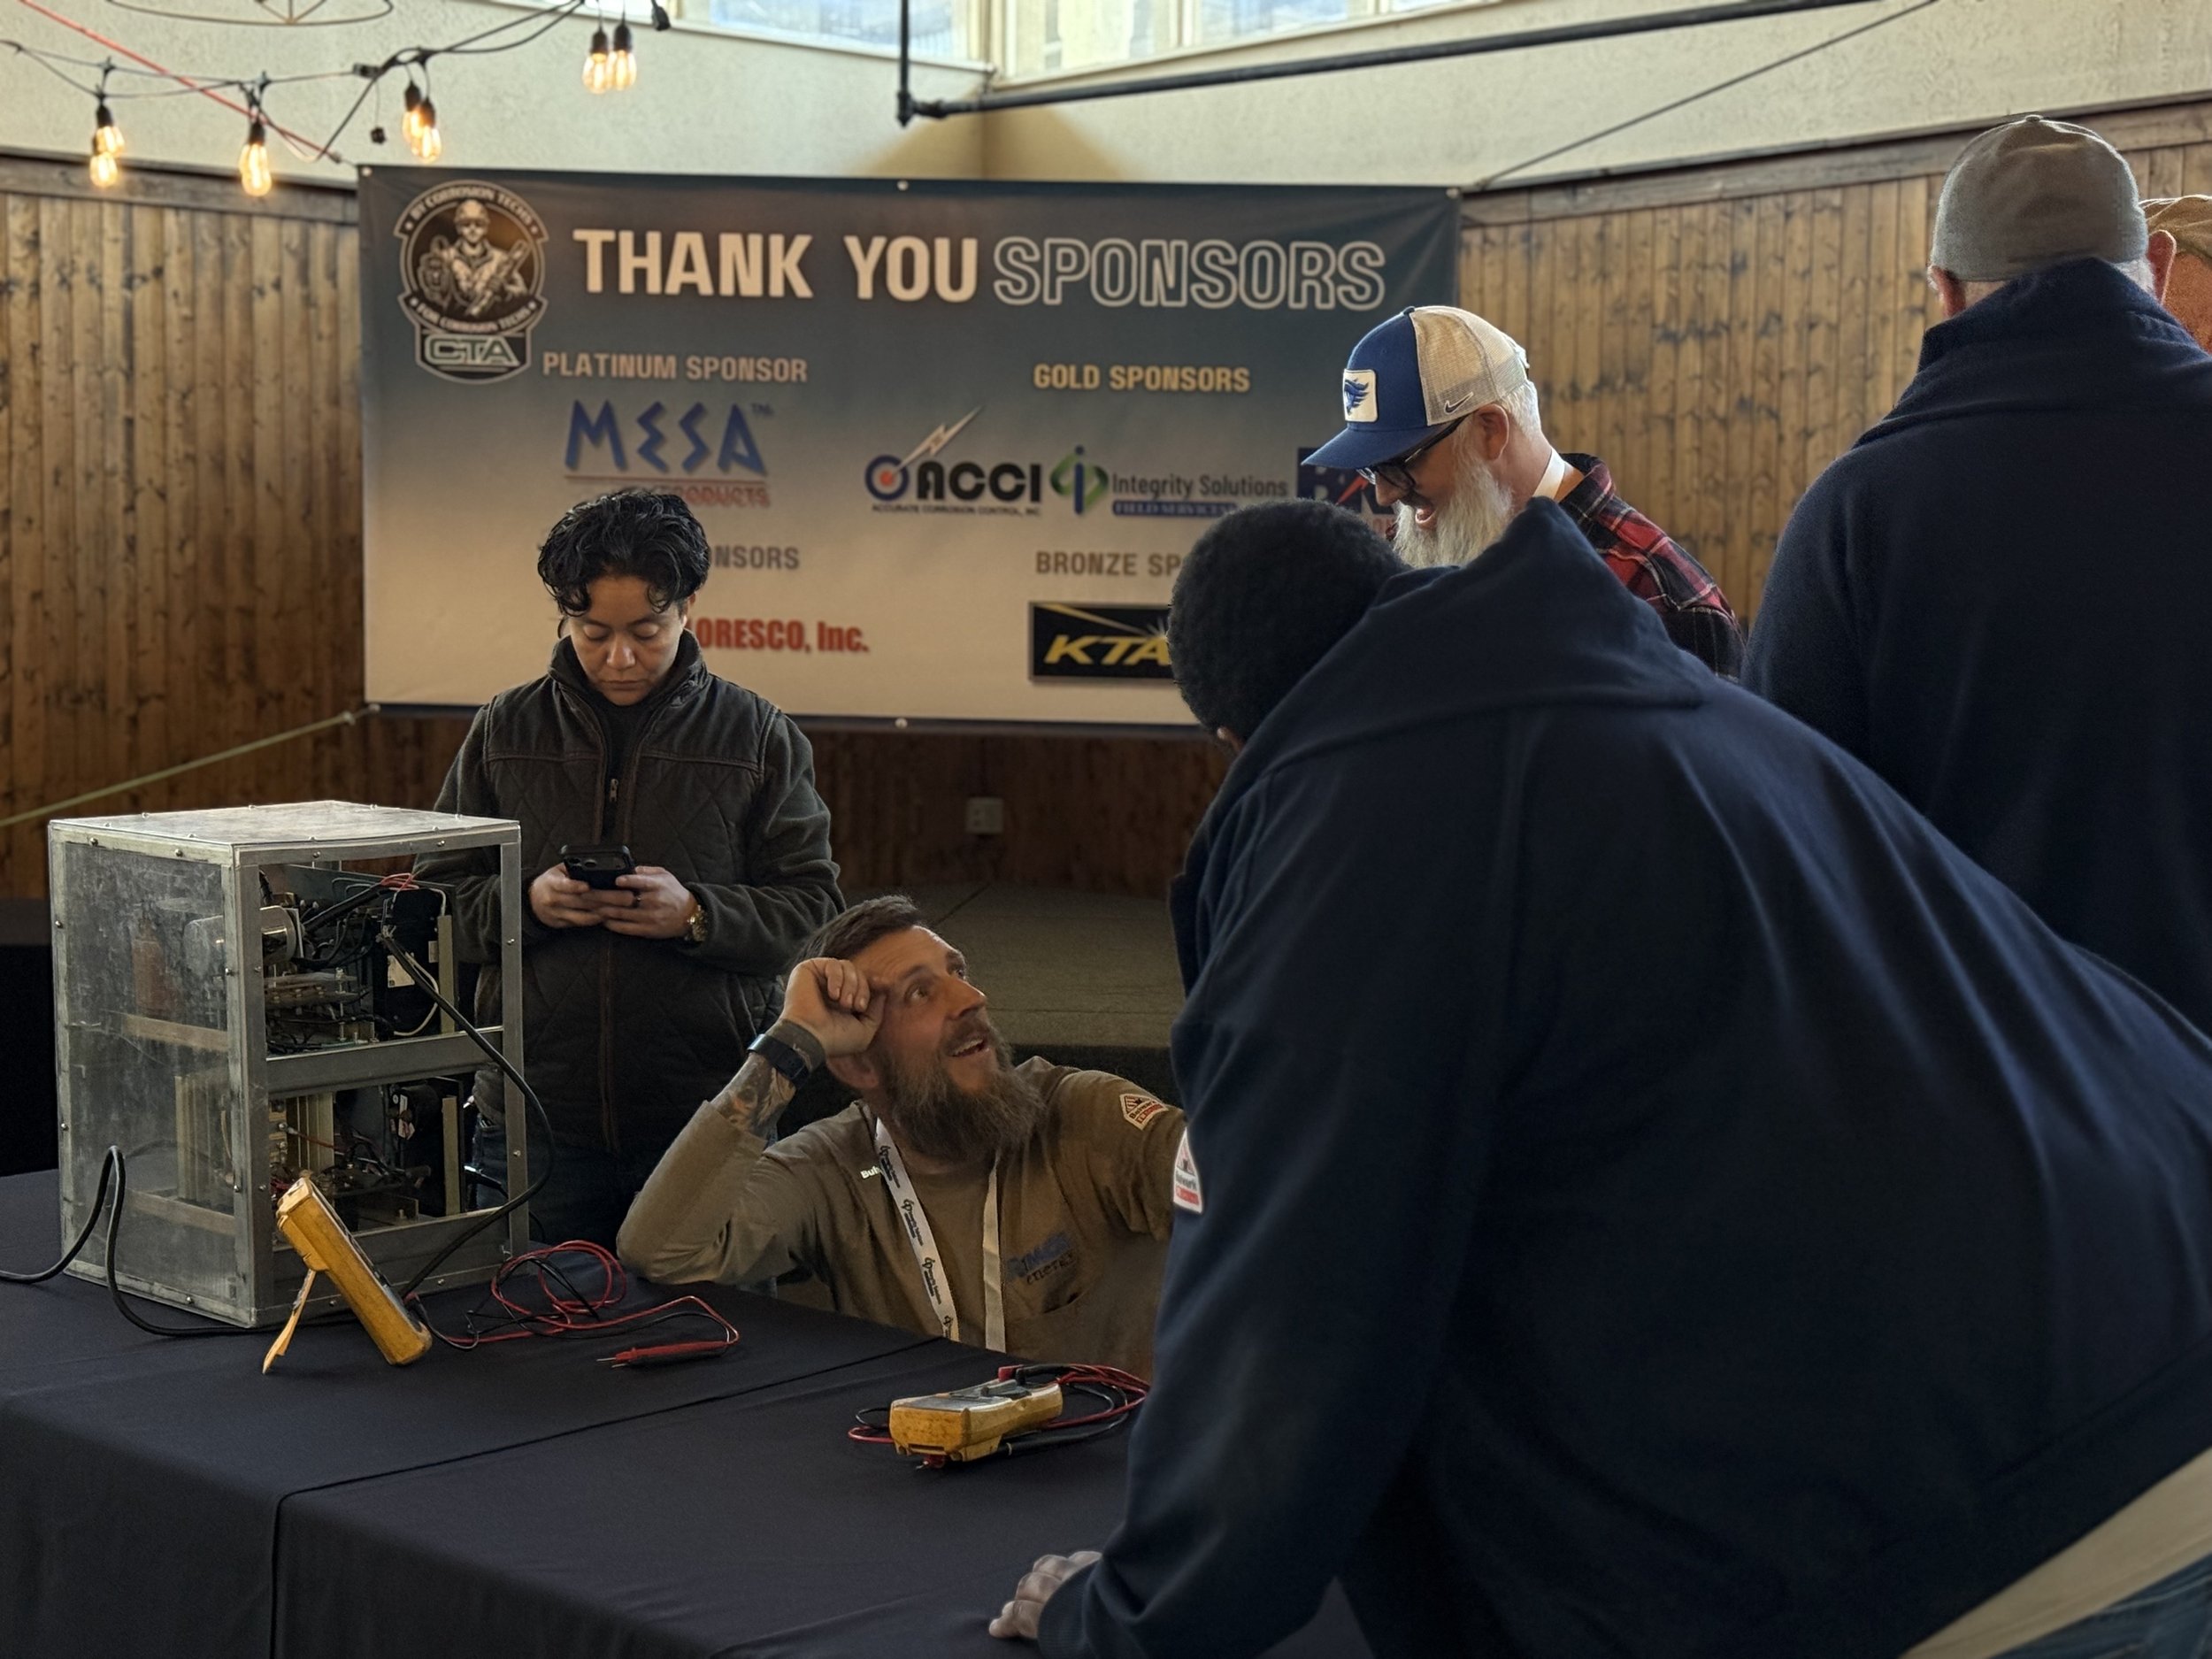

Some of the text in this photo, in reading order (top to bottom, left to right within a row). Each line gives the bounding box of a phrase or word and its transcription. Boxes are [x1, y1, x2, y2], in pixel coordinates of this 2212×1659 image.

[572, 229, 1386, 311] THANK YOU SPONSORS
[425, 334, 519, 366] CTA
[542, 351, 808, 383] PLATINUM SPONSOR
[1033, 364, 1250, 392] GOLD SPONSORS
[565, 399, 768, 476] MESA
[918, 460, 1041, 503] ACCI
[1112, 473, 1288, 498] Integrity Solutions
[1036, 551, 1138, 576] BRONZE
[687, 618, 870, 654] ORESCO, Inc.
[1043, 634, 1171, 666] KTA
